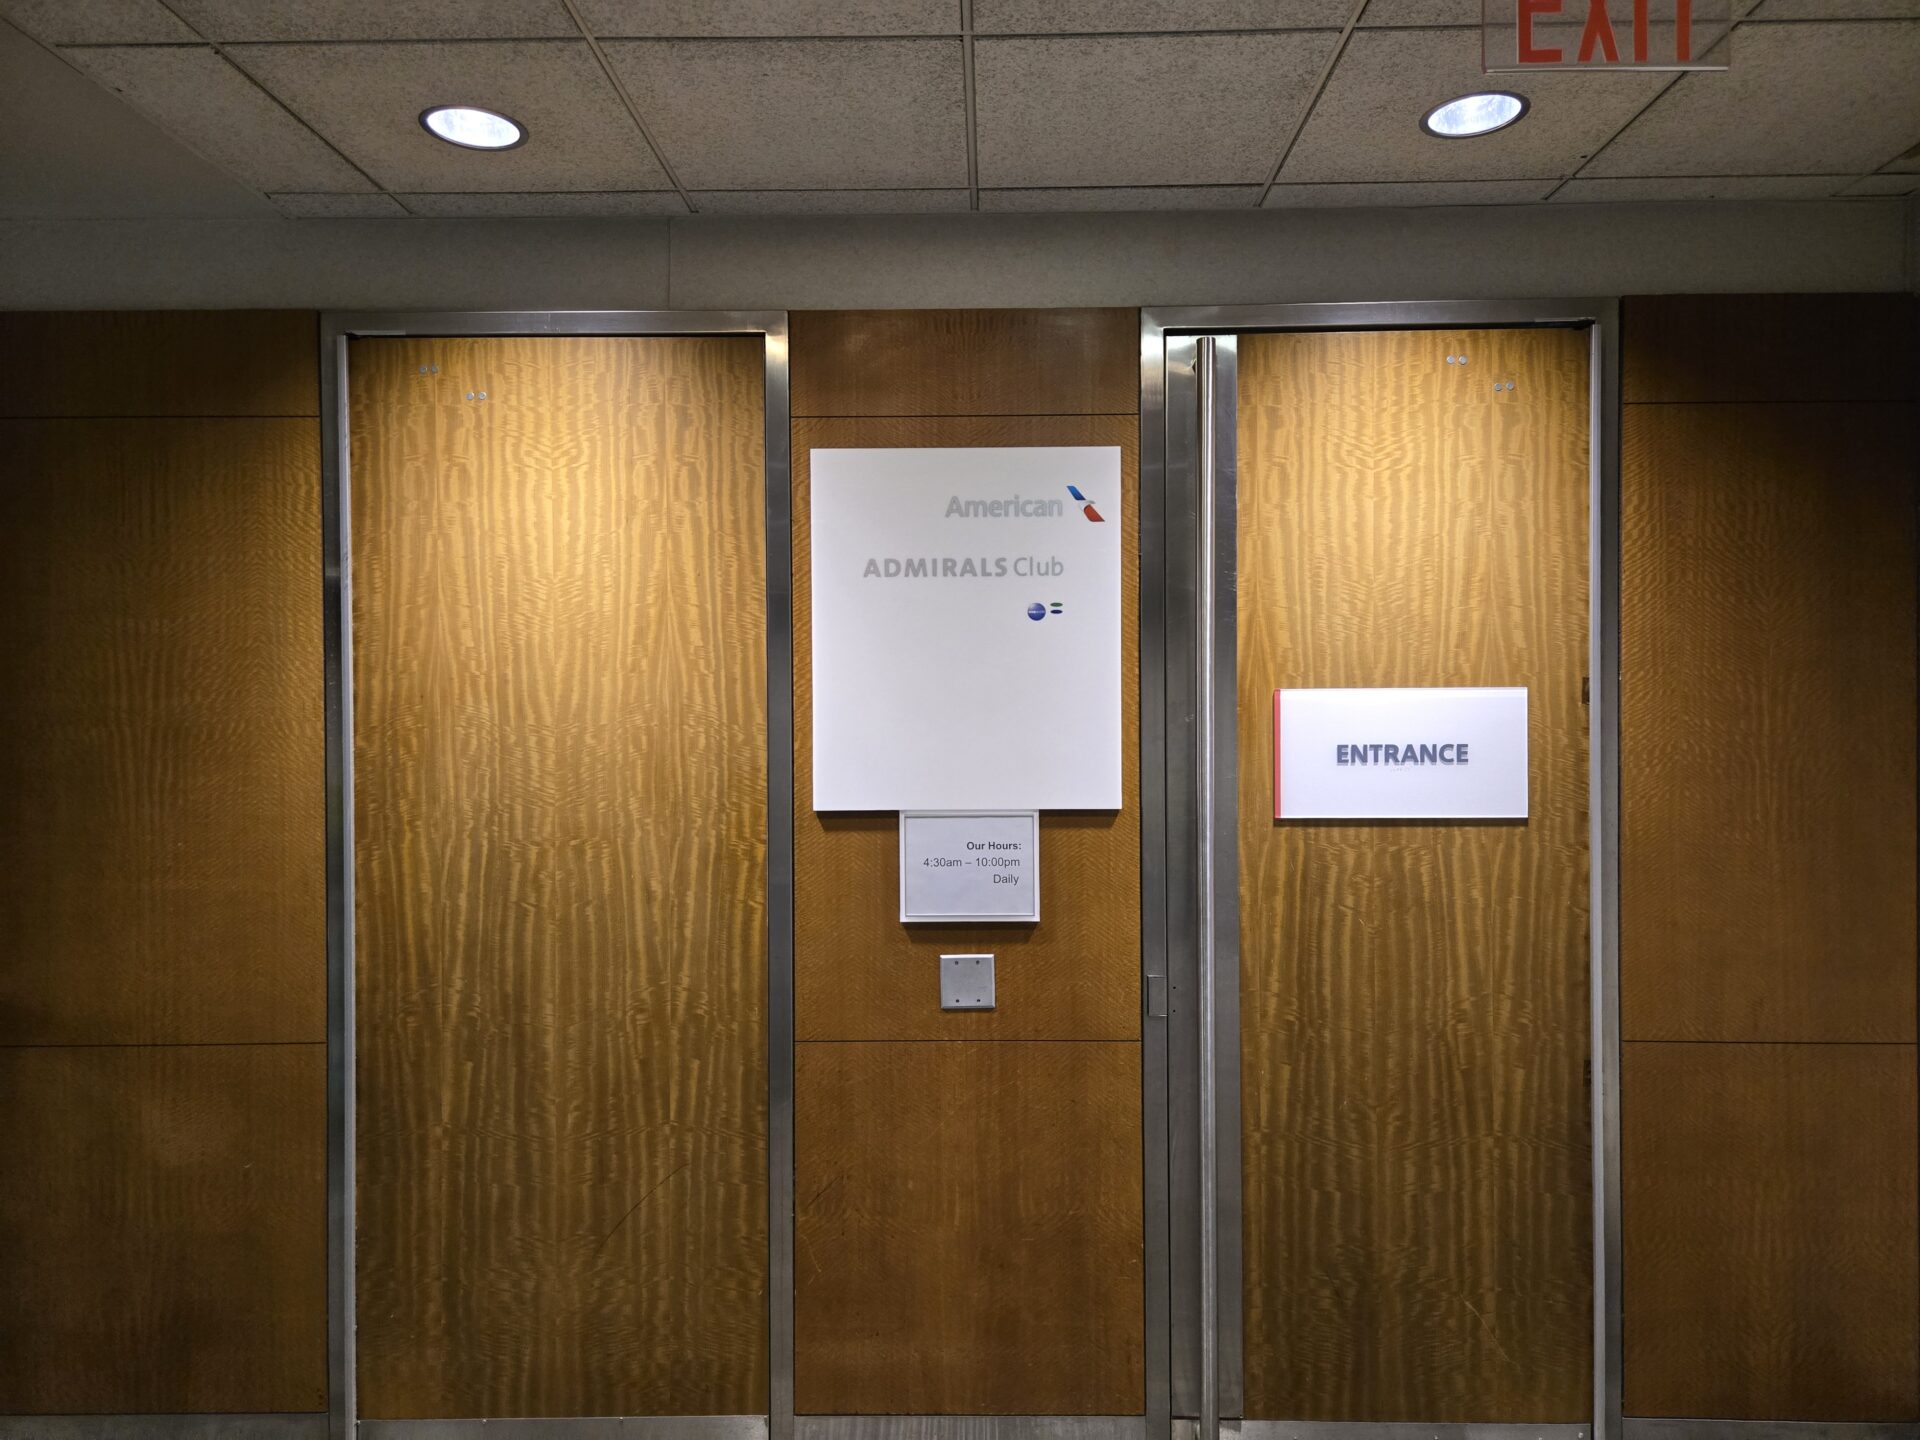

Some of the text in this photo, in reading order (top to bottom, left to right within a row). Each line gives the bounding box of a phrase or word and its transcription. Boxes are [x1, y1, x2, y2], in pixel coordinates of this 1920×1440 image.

[944, 494, 1063, 519] American
[863, 555, 1064, 578] ADMIRALS Club
[1336, 743, 1469, 766] ENTRANCE
[966, 841, 1022, 851] Our Hours:
[923, 857, 963, 868] 4:30am
[975, 857, 1021, 869] 10:00pm
[993, 873, 1020, 886] Daily
